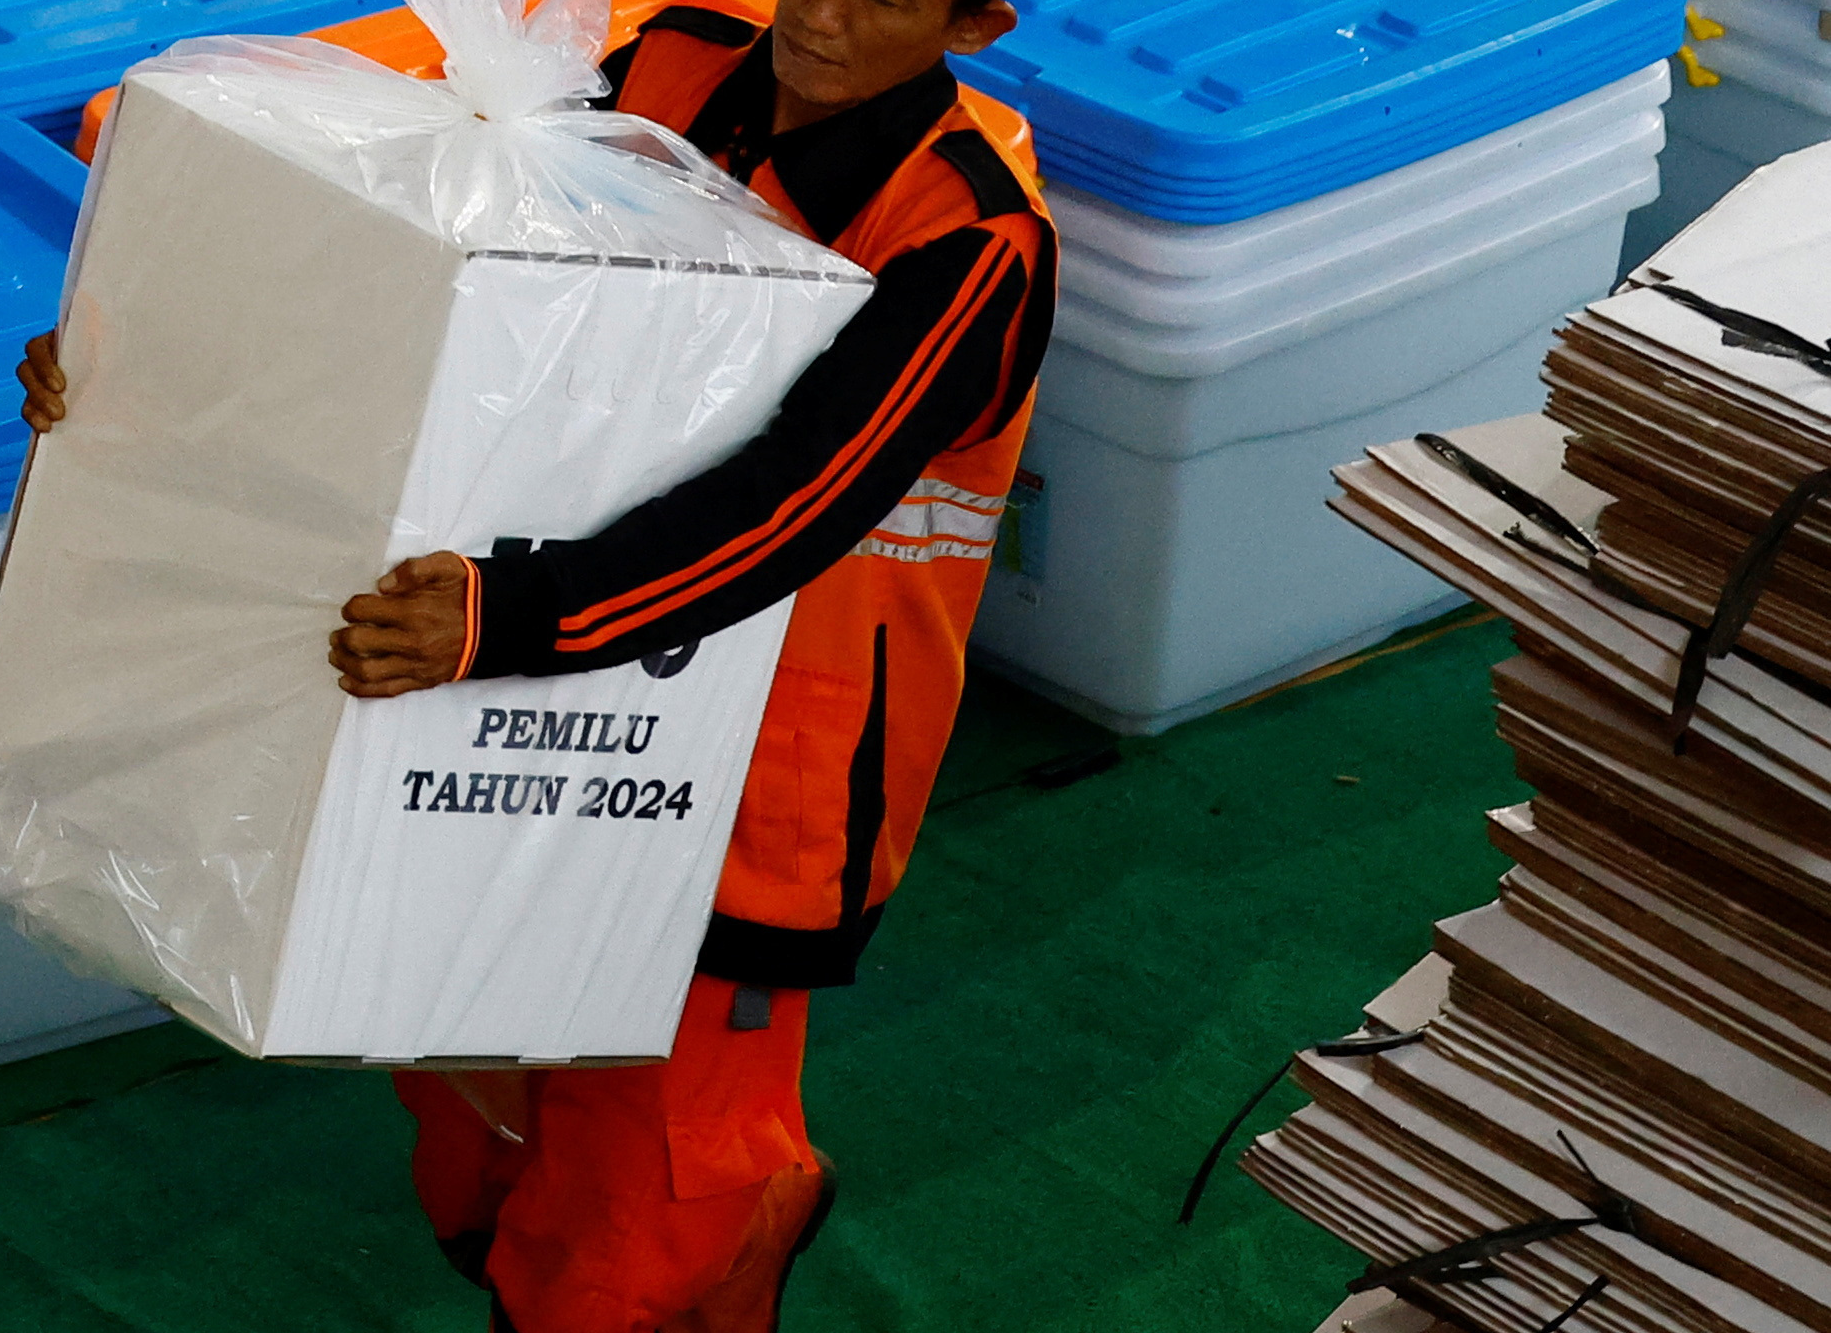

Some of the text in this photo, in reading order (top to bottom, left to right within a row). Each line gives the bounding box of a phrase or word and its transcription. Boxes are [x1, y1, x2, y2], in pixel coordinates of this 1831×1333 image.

[472, 707, 661, 756] PEMILU
[401, 769, 695, 822] TAHUN 2024
